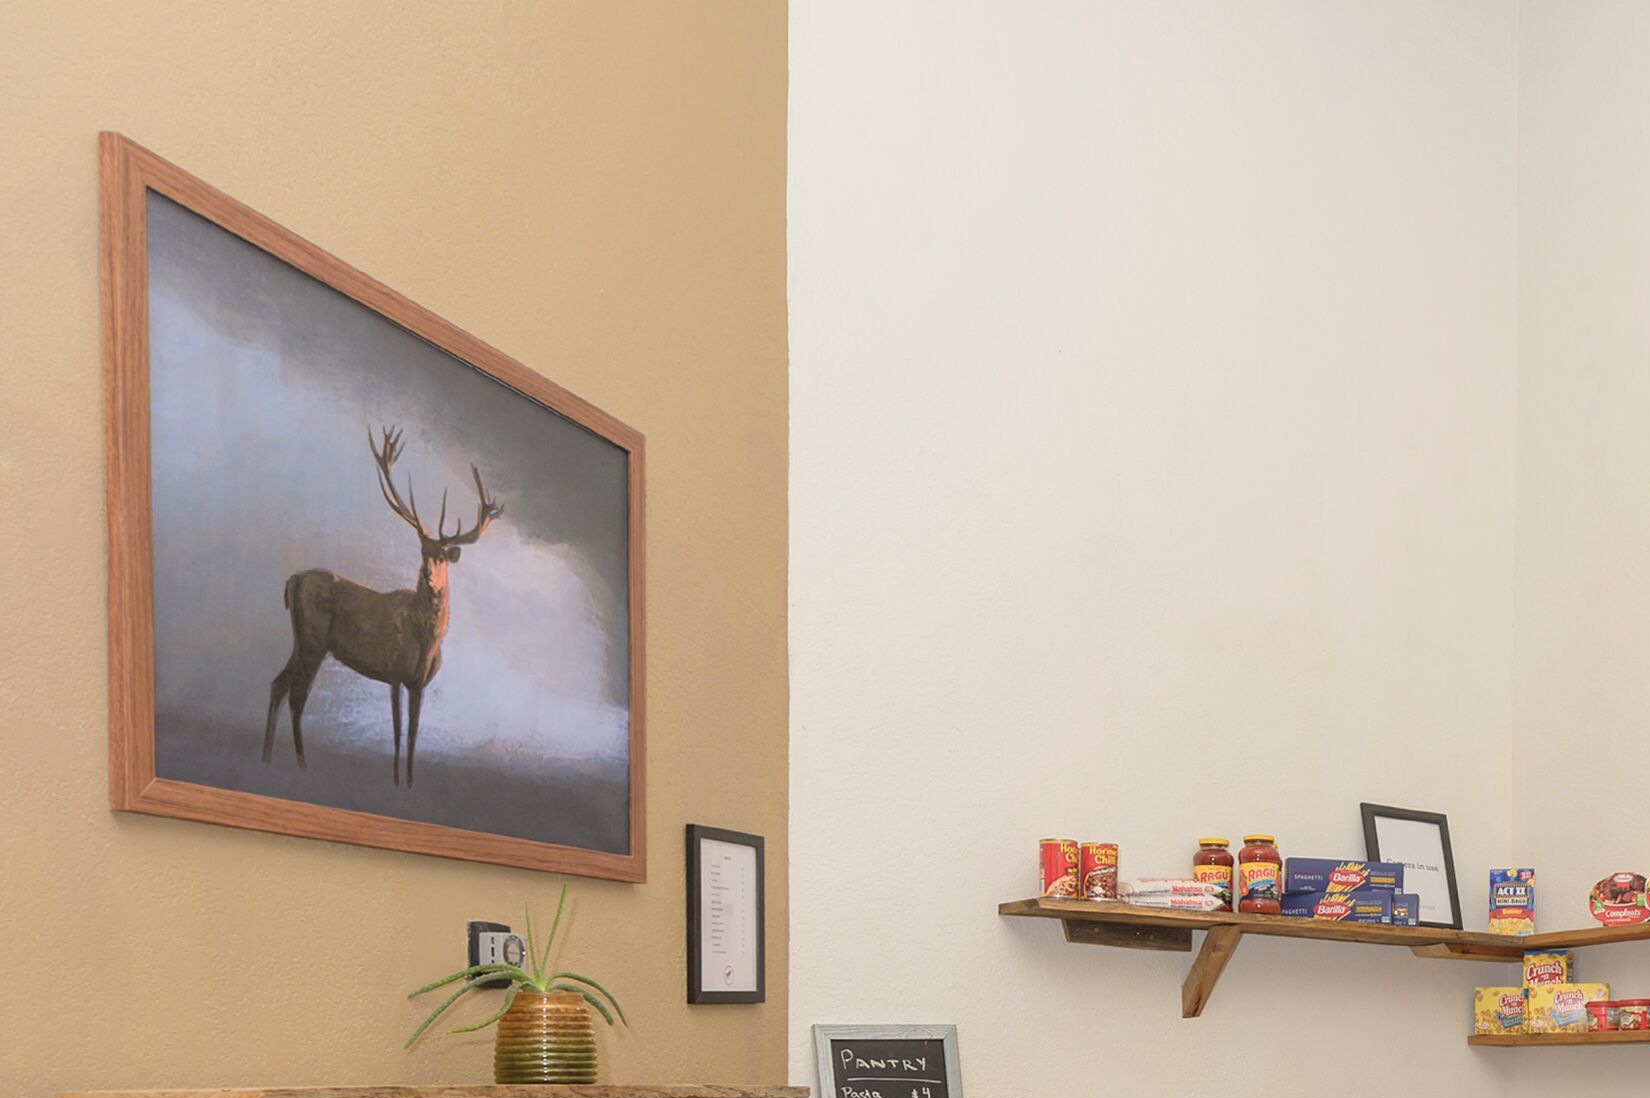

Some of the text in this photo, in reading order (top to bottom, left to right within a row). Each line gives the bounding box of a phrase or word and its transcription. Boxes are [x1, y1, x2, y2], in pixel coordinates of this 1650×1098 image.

[1426, 865, 1439, 873] use
[1333, 873, 1361, 883] Barilla
[1498, 887, 1526, 896] ACT II
[1318, 906, 1346, 915] Barilla
[1605, 910, 1641, 918] Compleats
[1527, 962, 1562, 980] Crunch
[1499, 995, 1523, 1007] Crunc
[1554, 990, 1583, 1004] Crunch
[1501, 1007, 1523, 1018] Munc
[840, 1048, 927, 1072] PANTRY
